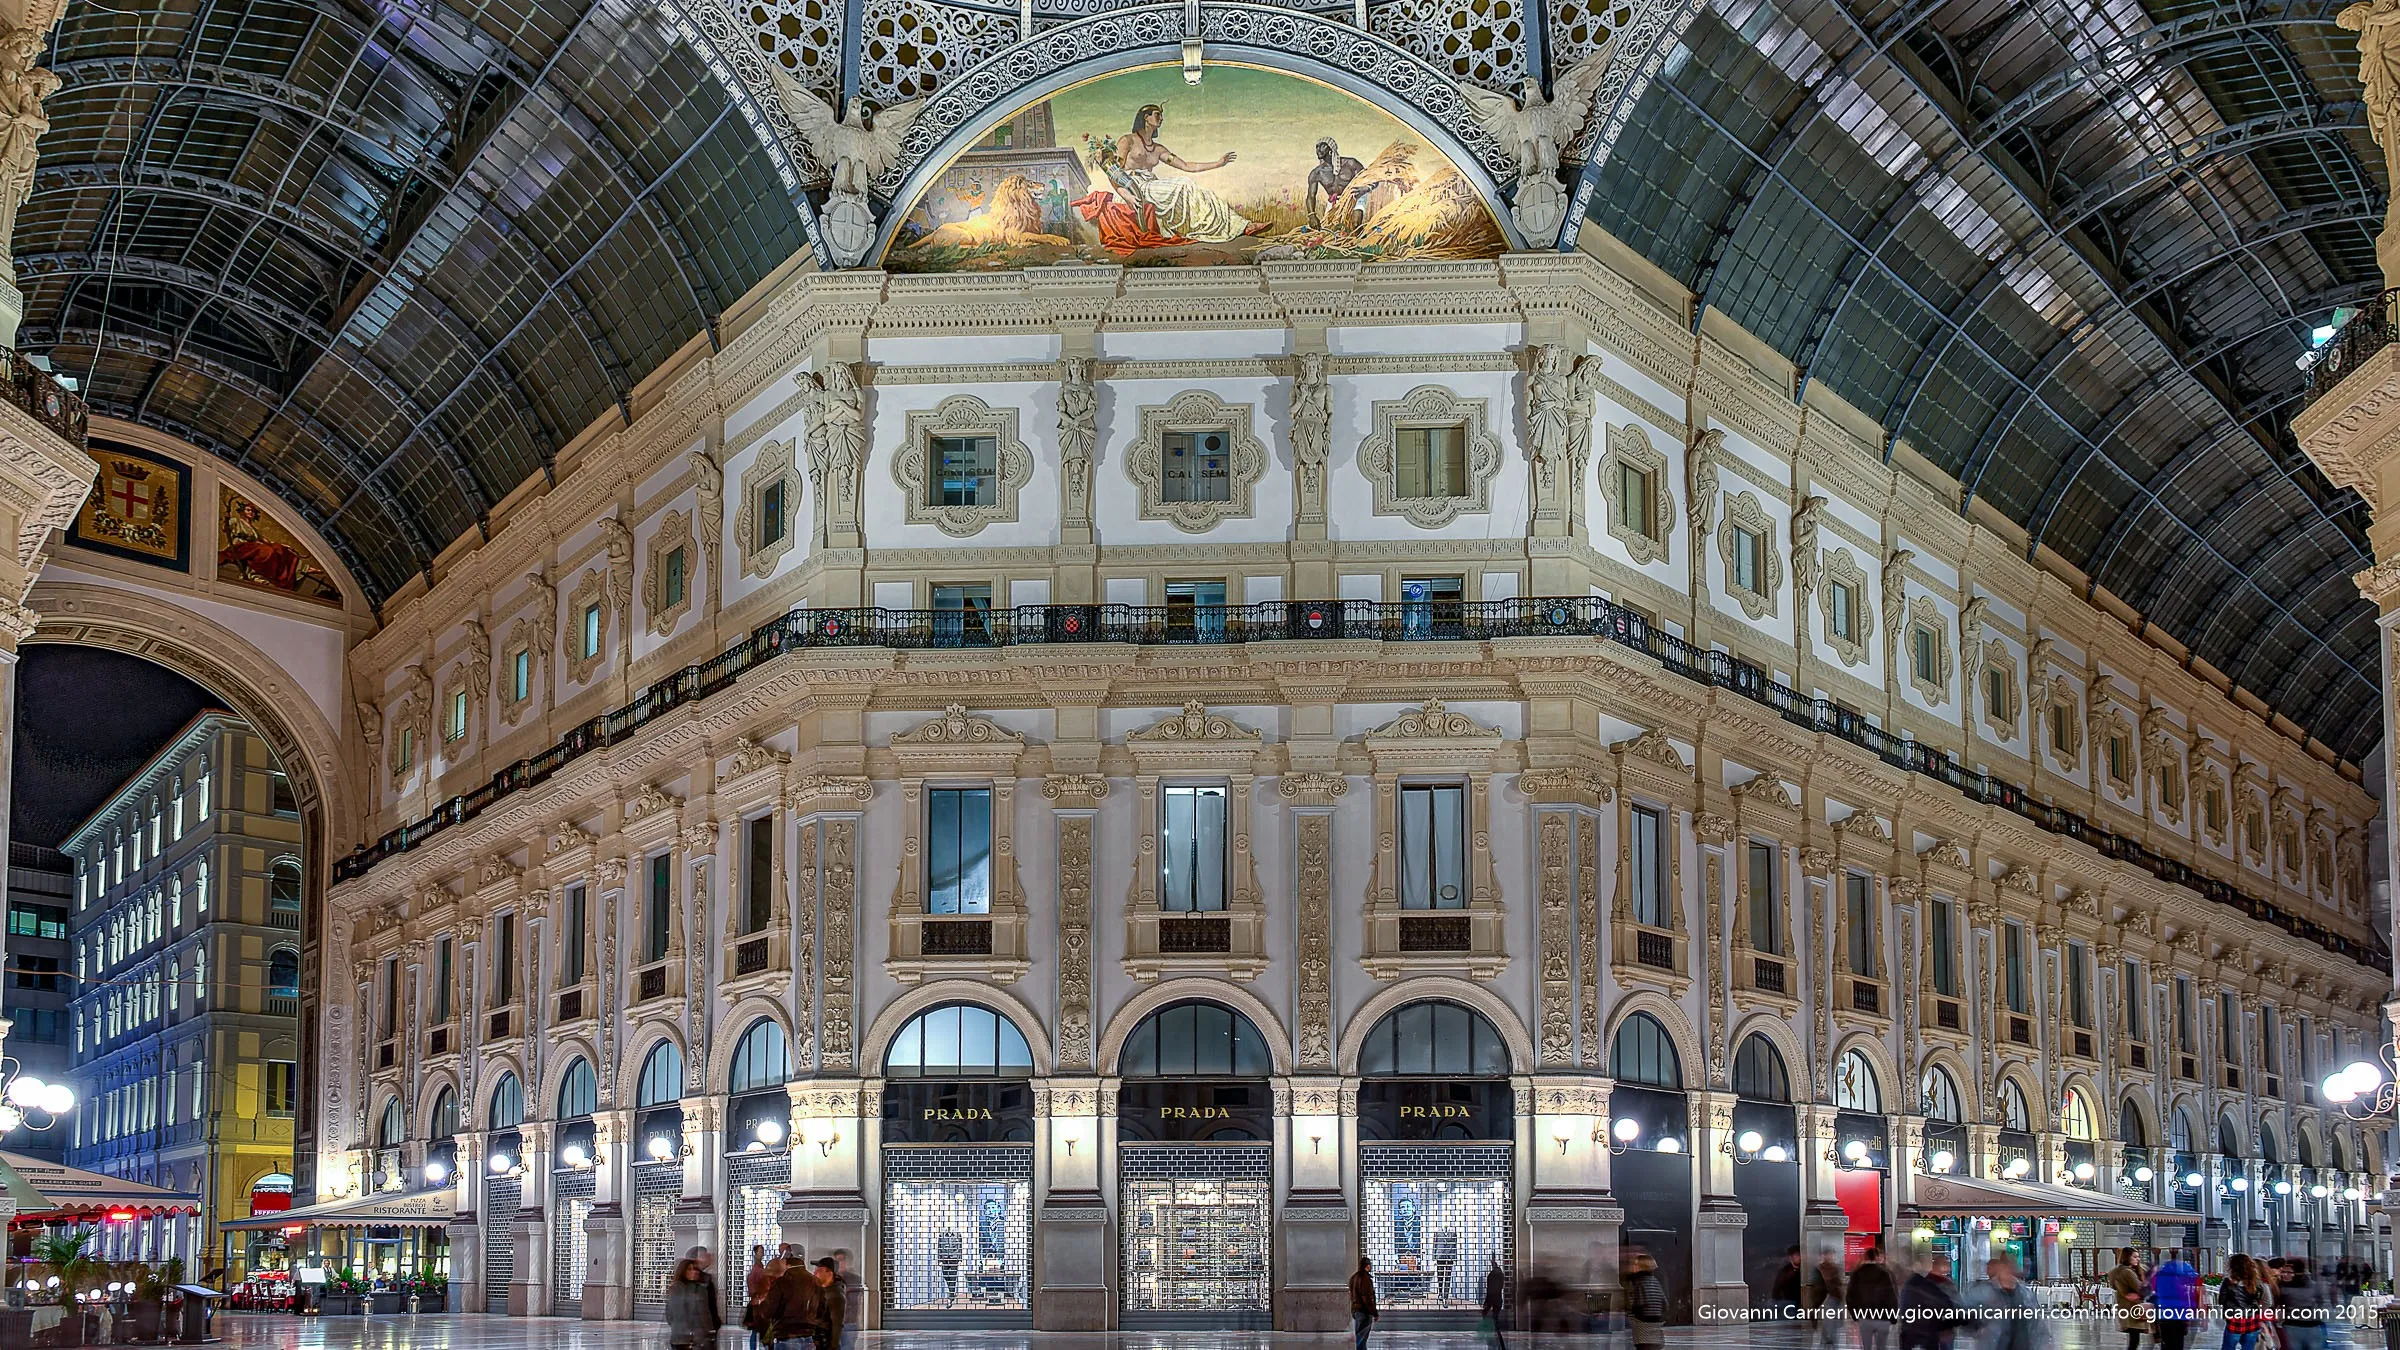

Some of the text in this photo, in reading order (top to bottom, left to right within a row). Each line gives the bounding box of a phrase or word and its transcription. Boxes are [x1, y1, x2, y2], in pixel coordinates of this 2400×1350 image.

[924, 1108, 993, 1121] PRADA
[1160, 1107, 1230, 1119] PRADA
[1400, 1105, 1470, 1118] PRADA
[373, 1206, 427, 1215] RISTORANTE
